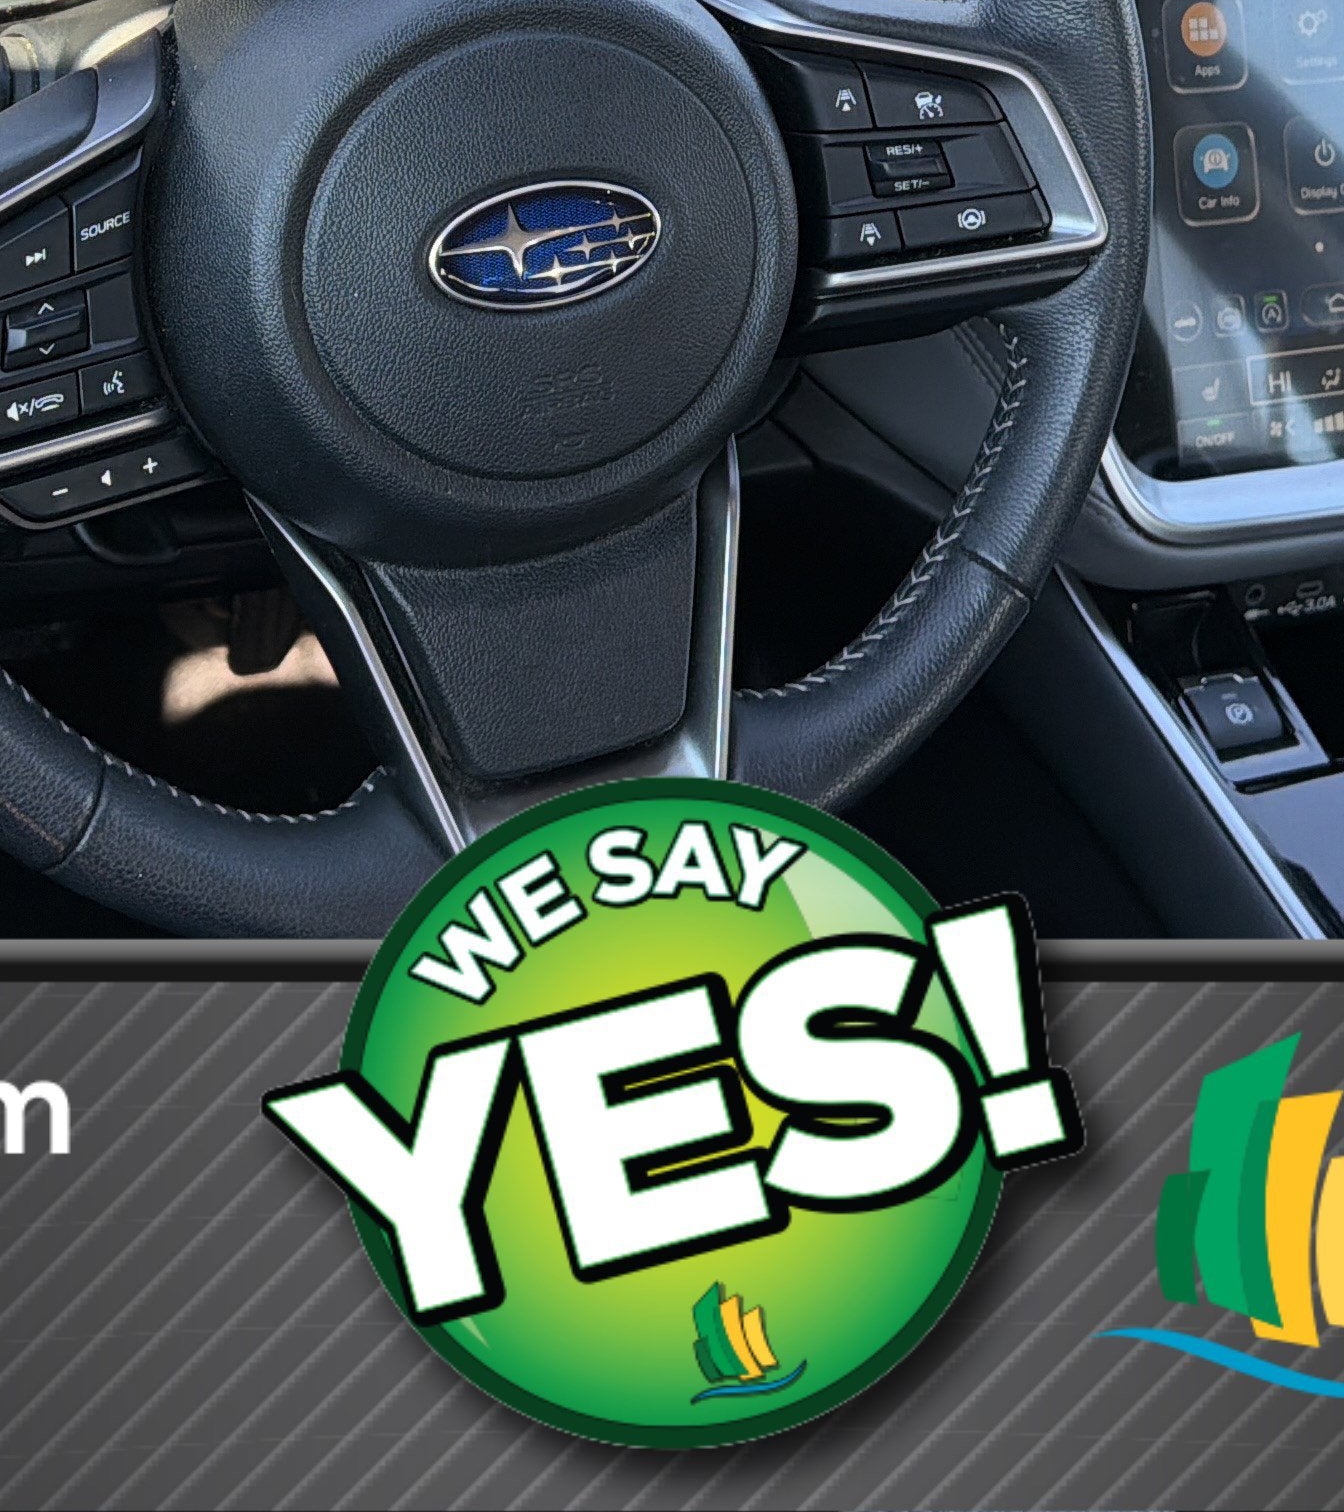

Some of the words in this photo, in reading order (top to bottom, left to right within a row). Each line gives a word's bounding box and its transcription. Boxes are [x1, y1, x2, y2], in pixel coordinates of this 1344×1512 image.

[1194, 64, 1221, 78] Apps
[886, 143, 924, 157] RES/+
[1300, 185, 1338, 201] Display
[1198, 196, 1218, 210] Car
[1221, 194, 1240, 208] Info
[80, 210, 132, 241] SOURCE
[1267, 370, 1292, 395] HI
